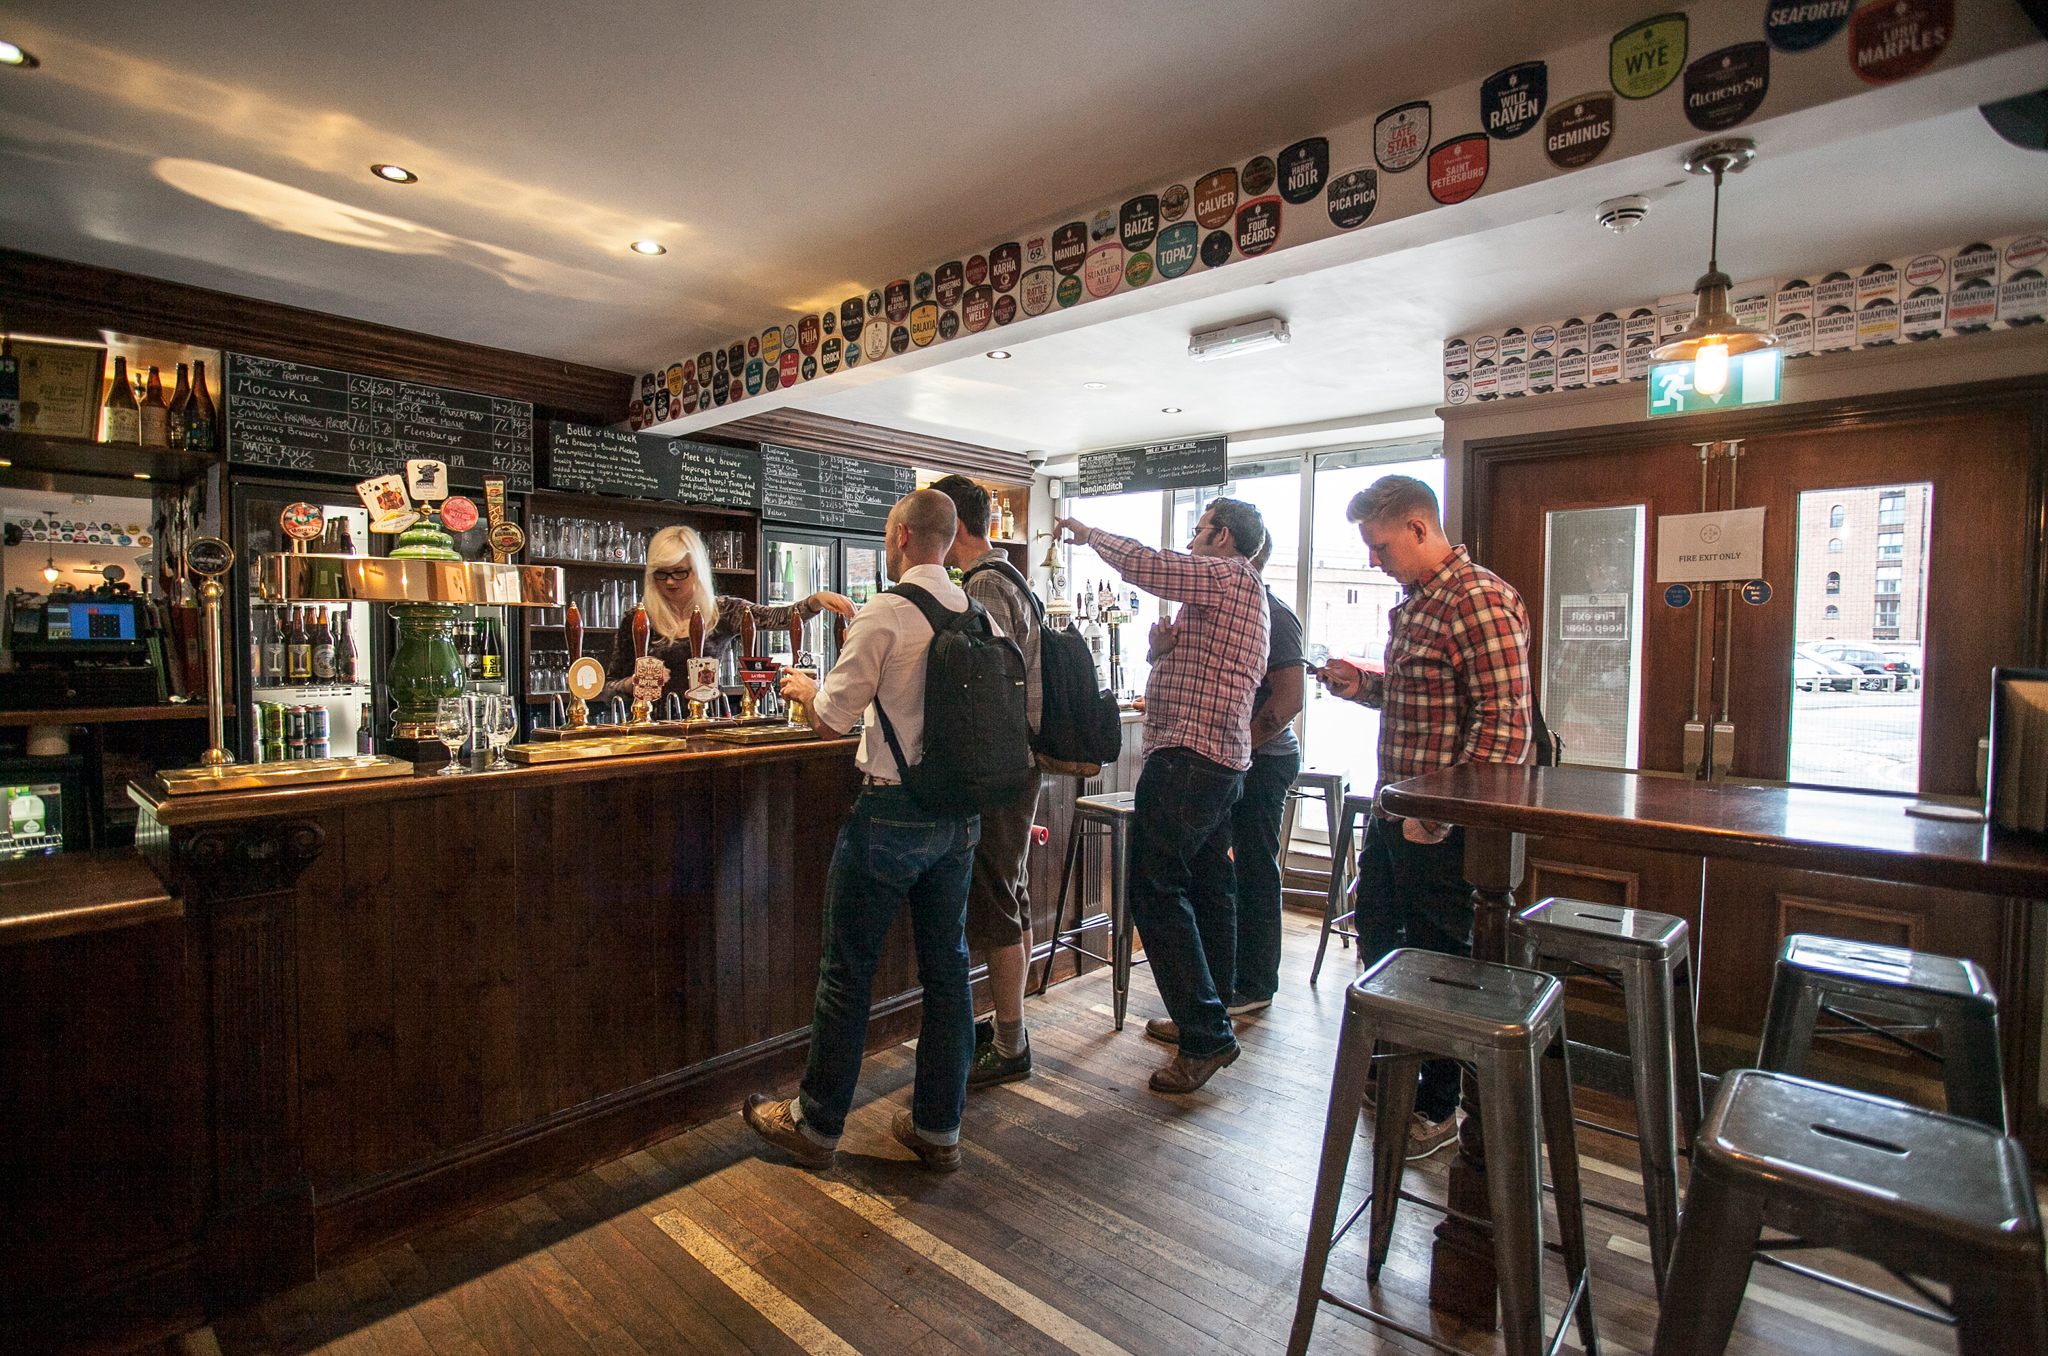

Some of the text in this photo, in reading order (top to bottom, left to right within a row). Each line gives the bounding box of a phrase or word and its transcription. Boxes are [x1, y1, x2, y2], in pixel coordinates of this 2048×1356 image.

[1769, 1, 1850, 27] SEAFORTH
[1857, 26, 1947, 67] MARPLES
[1625, 45, 1668, 76] WYE
[1501, 92, 1526, 109] WILD
[1490, 98, 1538, 130] RAVEN
[1392, 126, 1412, 140] LATE
[1548, 121, 1610, 152] GEMINUS
[1388, 134, 1416, 154] STAR
[1292, 161, 1314, 176] HARRY
[1446, 162, 1470, 177] SAINT
[1288, 169, 1318, 190] NOIR
[1432, 167, 1484, 190] PETERSBURG
[1198, 192, 1234, 216] CALVER
[1330, 188, 1376, 213] PICA PICA
[1124, 216, 1154, 238] BAIZE
[1248, 219, 1268, 233] FOUR
[1240, 226, 1276, 247] BEARDS
[1054, 242, 1085, 262] MANIOLA
[1160, 244, 1193, 266] TOPAZ
[1954, 253, 1996, 268] QUANTUM
[994, 260, 1016, 276] KARHA
[1088, 264, 1120, 280] SUMMER
[937, 278, 962, 292] CHRISTMAS
[1096, 275, 1111, 286] ALE
[1859, 272, 1898, 287] QUANTUM
[1026, 284, 1048, 296] RATTLE
[1817, 282, 1854, 294] QUANTUM
[2002, 280, 2048, 294] QUANTUM
[1778, 290, 1814, 302] QUANTUM
[1817, 292, 1844, 302] BREWING
[1845, 290, 1854, 298] CO
[1904, 296, 1944, 310] QUANTUM
[1952, 290, 1995, 302] QUANTUM
[1735, 300, 1768, 313] QUANTUM
[968, 310, 986, 322] WELL
[1860, 308, 1898, 320] QUANTUM
[912, 320, 936, 334] GALAXIA
[1592, 322, 1620, 332] QUANTUM
[1626, 318, 1656, 328] QUANTUM
[1776, 322, 1811, 336] QUANTUM
[1818, 316, 1854, 328] QUANTUM
[801, 329, 818, 345] PUJA
[1560, 326, 1586, 337] QUANTUM
[1818, 326, 1844, 335] BREWING
[1501, 336, 1526, 346] QUANTUM
[822, 350, 840, 364] BROCK
[1445, 347, 1468, 357] QUANTUM
[1591, 352, 1620, 363] QUANTUM
[1529, 359, 1554, 368] QUANTUM
[1559, 357, 1586, 368] QUANTUM
[246, 366, 274, 378] SPACE
[1473, 368, 1498, 378] QUANTUM
[1500, 366, 1526, 376] QUANTUM
[1501, 374, 1518, 382] BREWING
[400, 384, 440, 400] Founders
[1451, 388, 1464, 398] SK2
[234, 420, 284, 434] Maximus
[566, 424, 592, 437] Bottle
[604, 430, 615, 440] the
[241, 432, 281, 444] Brutus
[404, 425, 462, 444] Flensburger
[555, 434, 568, 445] Port
[572, 438, 597, 451] Brewing
[601, 442, 617, 452] Board
[244, 452, 282, 466] SALTY
[451, 455, 465, 466] IPA
[682, 452, 742, 468] Meet the brewer
[682, 462, 736, 479] Hopcraft bring 5
[680, 474, 708, 486] exciting
[744, 482, 756, 490] food
[678, 488, 698, 501] Monday
[1699, 554, 1718, 562] EXIT
[1720, 552, 1741, 560] ONLY
[638, 678, 658, 686] RAPTURE
